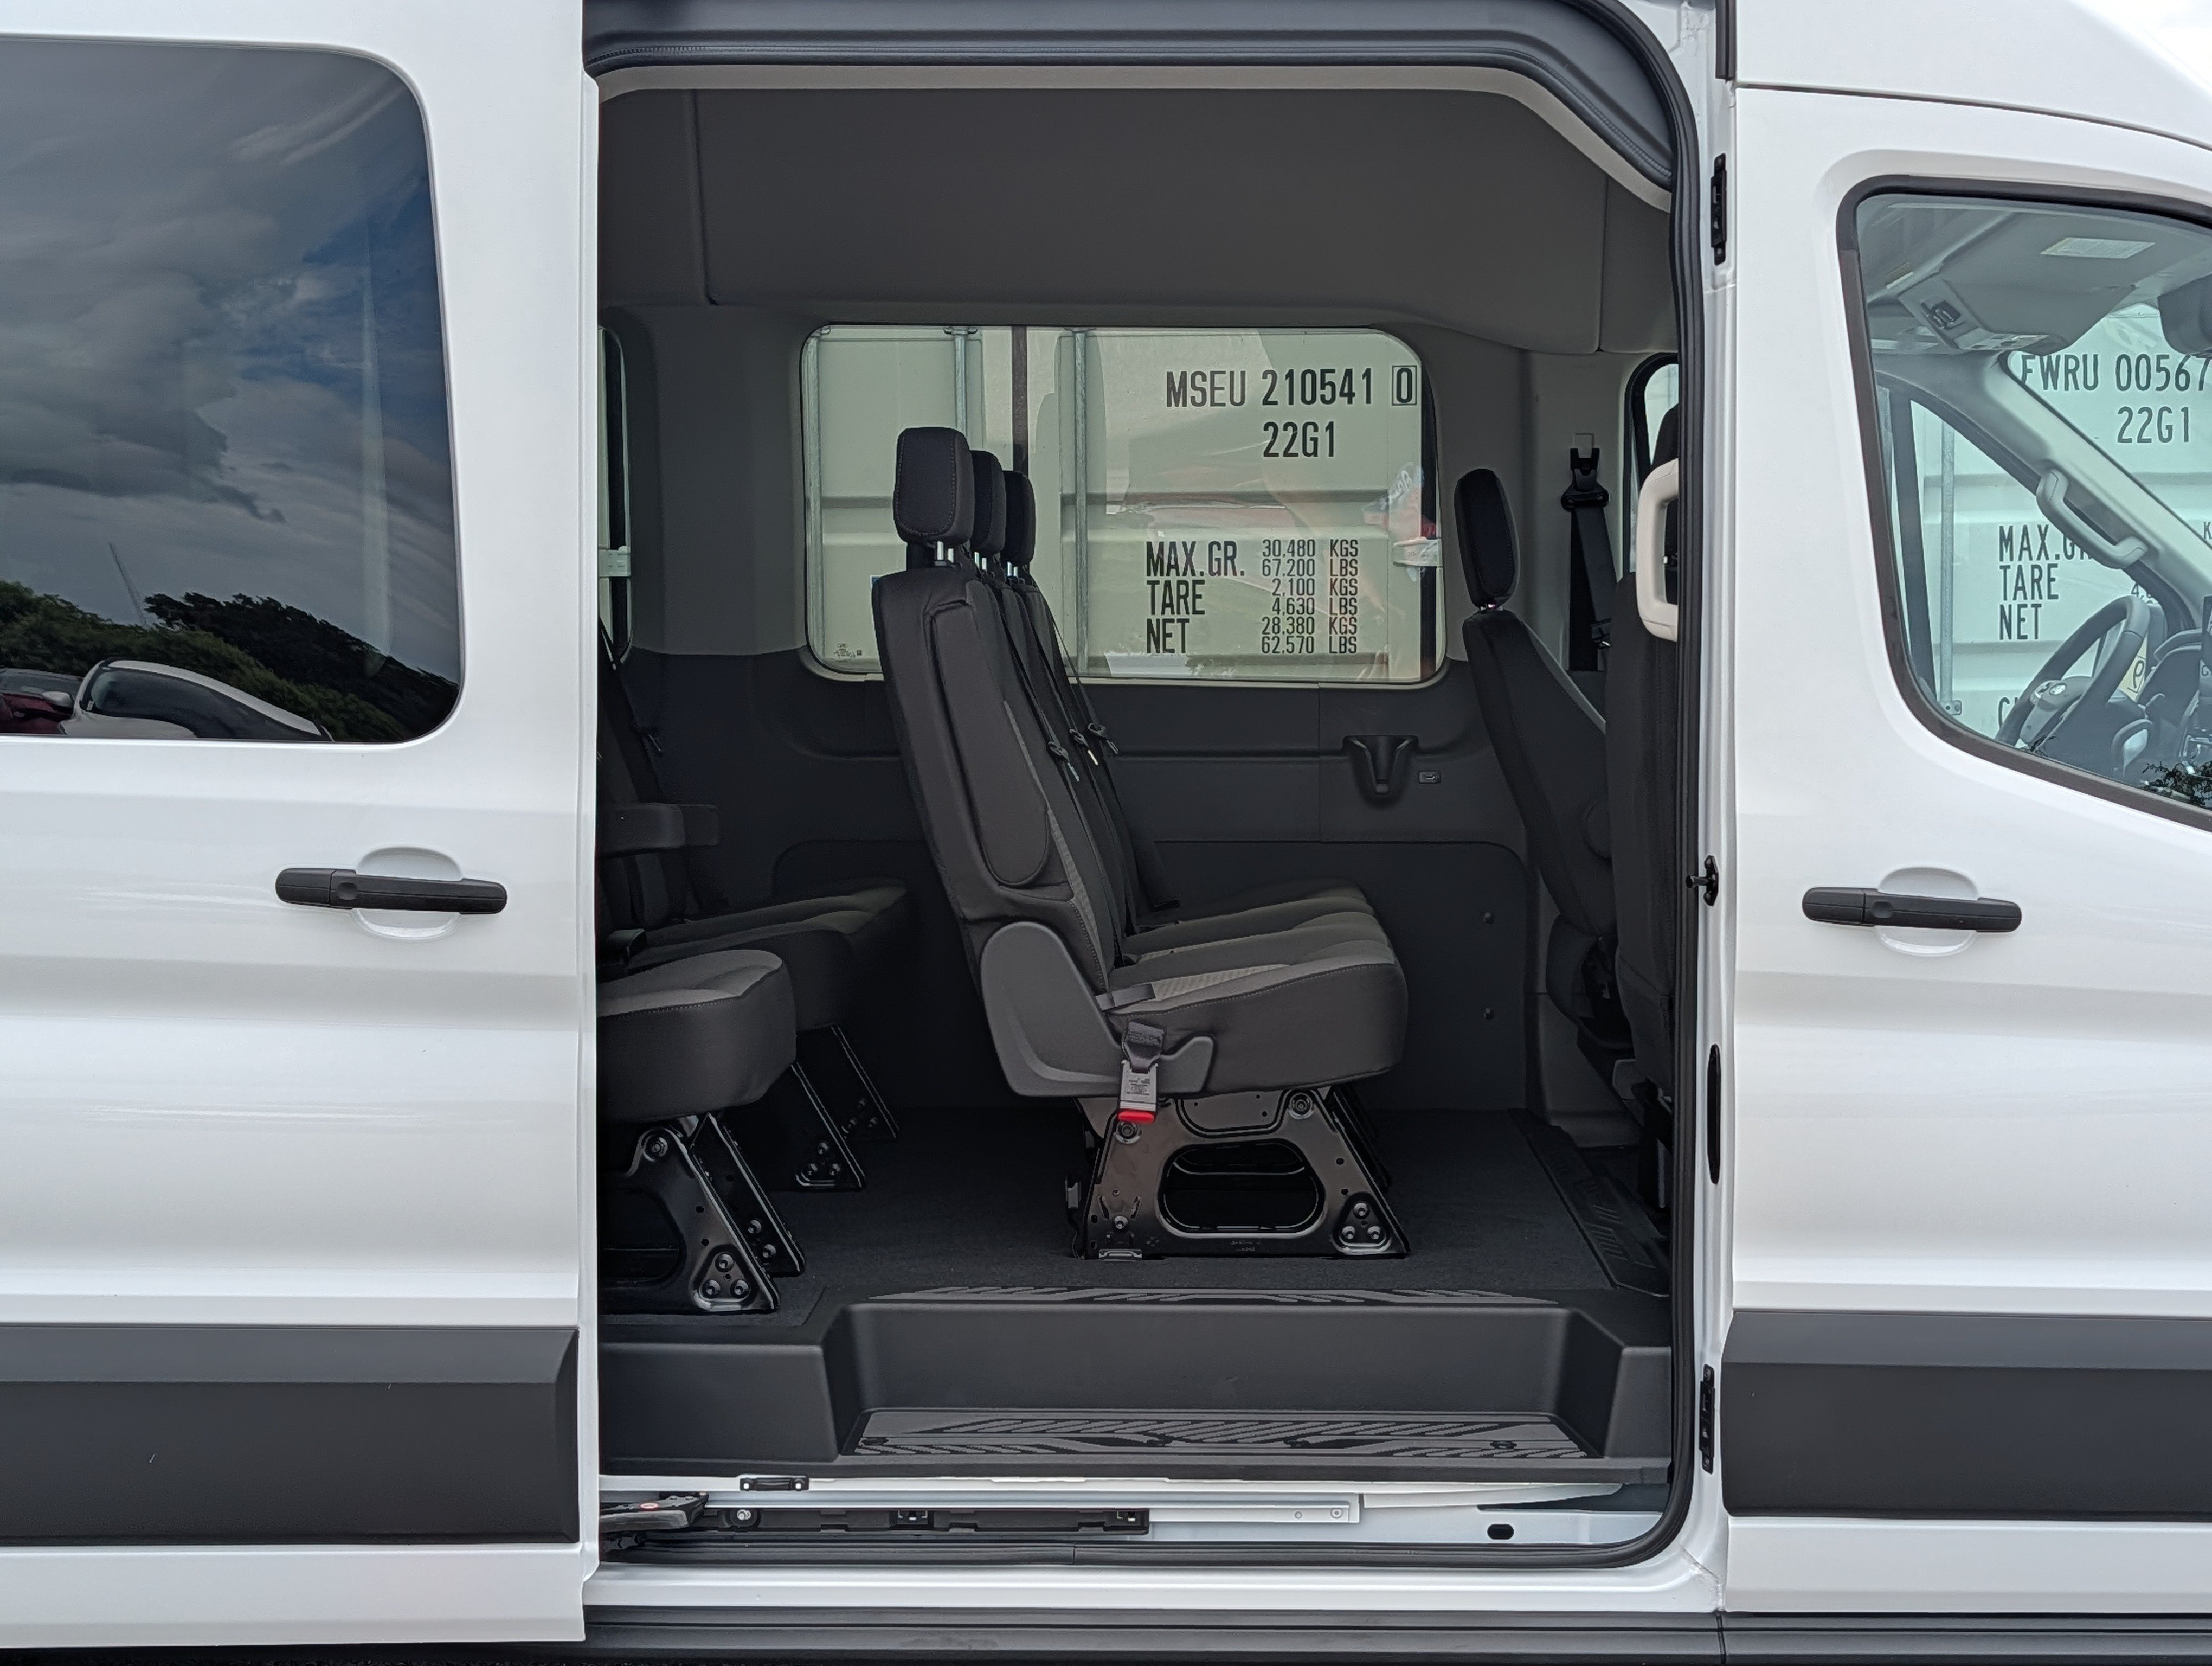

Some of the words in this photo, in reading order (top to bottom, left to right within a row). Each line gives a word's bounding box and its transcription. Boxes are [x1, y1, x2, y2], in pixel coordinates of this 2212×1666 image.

[1166, 370, 1246, 407] MSEU
[1262, 368, 1372, 406] 210541
[1396, 368, 1413, 403] 0
[1263, 421, 1334, 458] 22G1
[2117, 406, 2189, 444] 22G1
[1330, 539, 1359, 558] KGS
[1330, 558, 1358, 577] LBS
[1999, 563, 2059, 601] TARE
[1146, 579, 1205, 616] TARE
[1329, 578, 1358, 597] KGS
[1329, 597, 1358, 616] LBS
[1999, 603, 2042, 640] NET
[1146, 618, 1190, 654] NET
[1329, 616, 1358, 635] KGS
[1329, 635, 1357, 655] LBS
